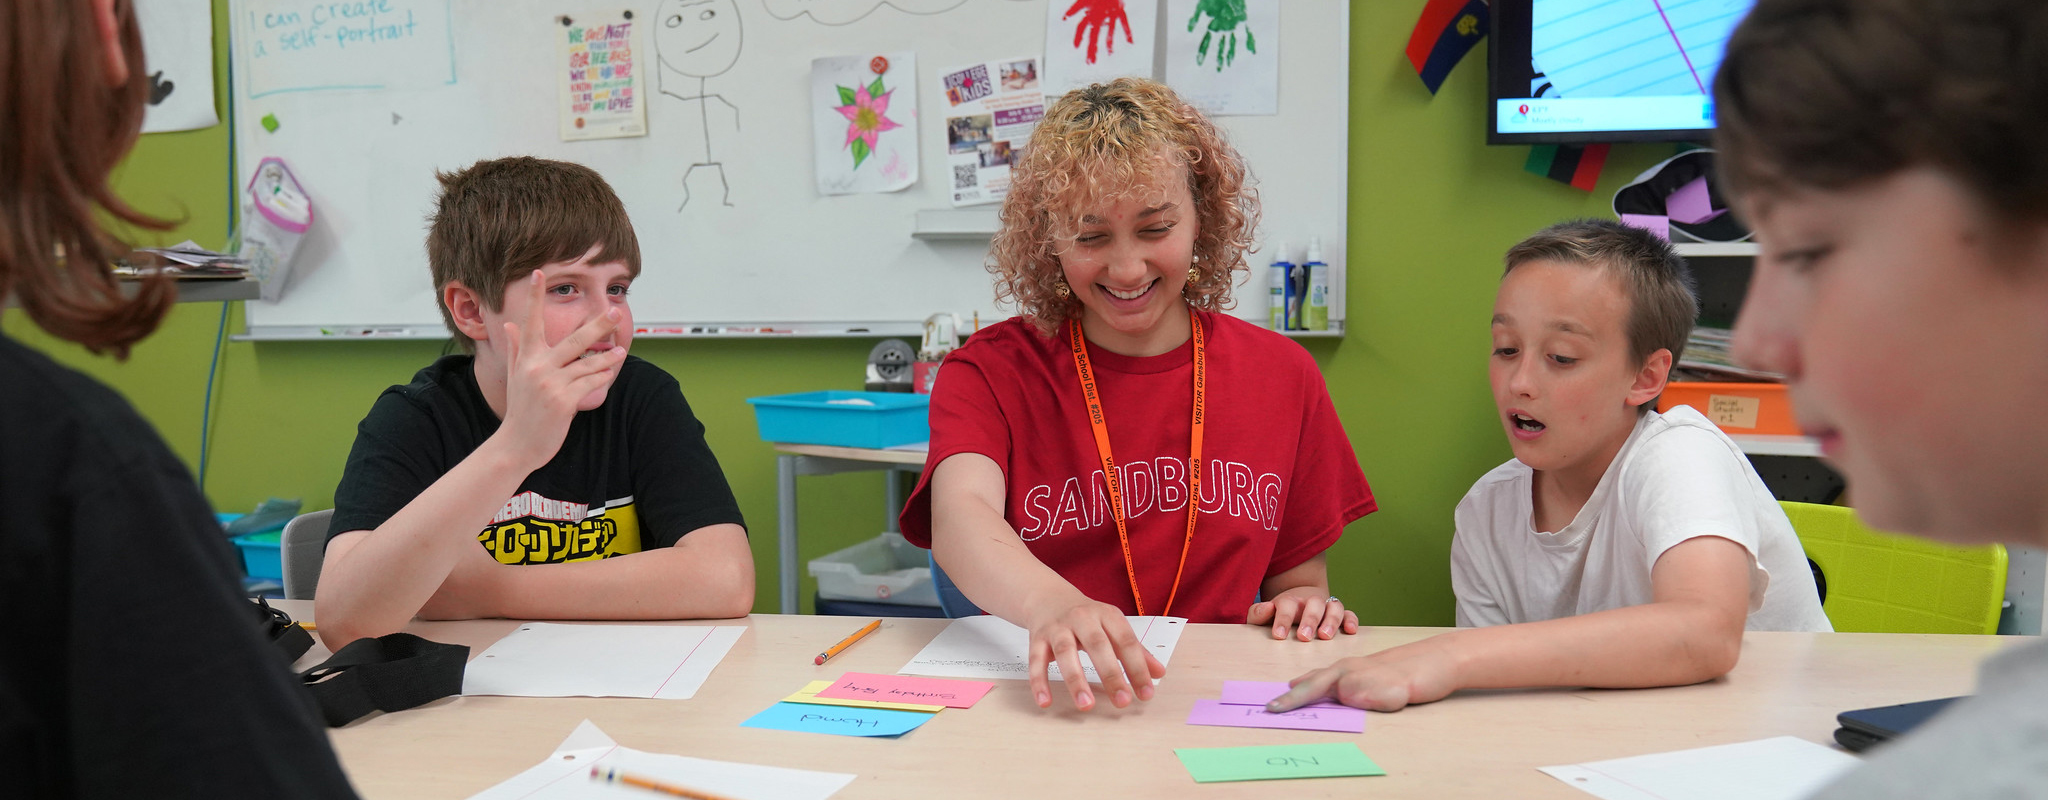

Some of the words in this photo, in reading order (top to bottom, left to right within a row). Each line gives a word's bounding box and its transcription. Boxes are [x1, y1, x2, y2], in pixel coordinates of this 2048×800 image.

[264, 12, 301, 29] can
[254, 40, 268, 58] a
[279, 9, 418, 50] self-portrait
[961, 80, 991, 102] KIDS
[1077, 353, 1092, 382] School
[1196, 347, 1204, 389] Galesburg
[1084, 382, 1096, 403] Dist.
[1090, 404, 1103, 425] #205
[1195, 390, 1203, 425] VISITOR
[1105, 456, 1120, 493] VISITOR
[1020, 456, 1282, 542] SANDBURG
[1192, 482, 1200, 502] Dist.
[889, 689, 957, 700] Birthday
[1265, 755, 1320, 768] NO
